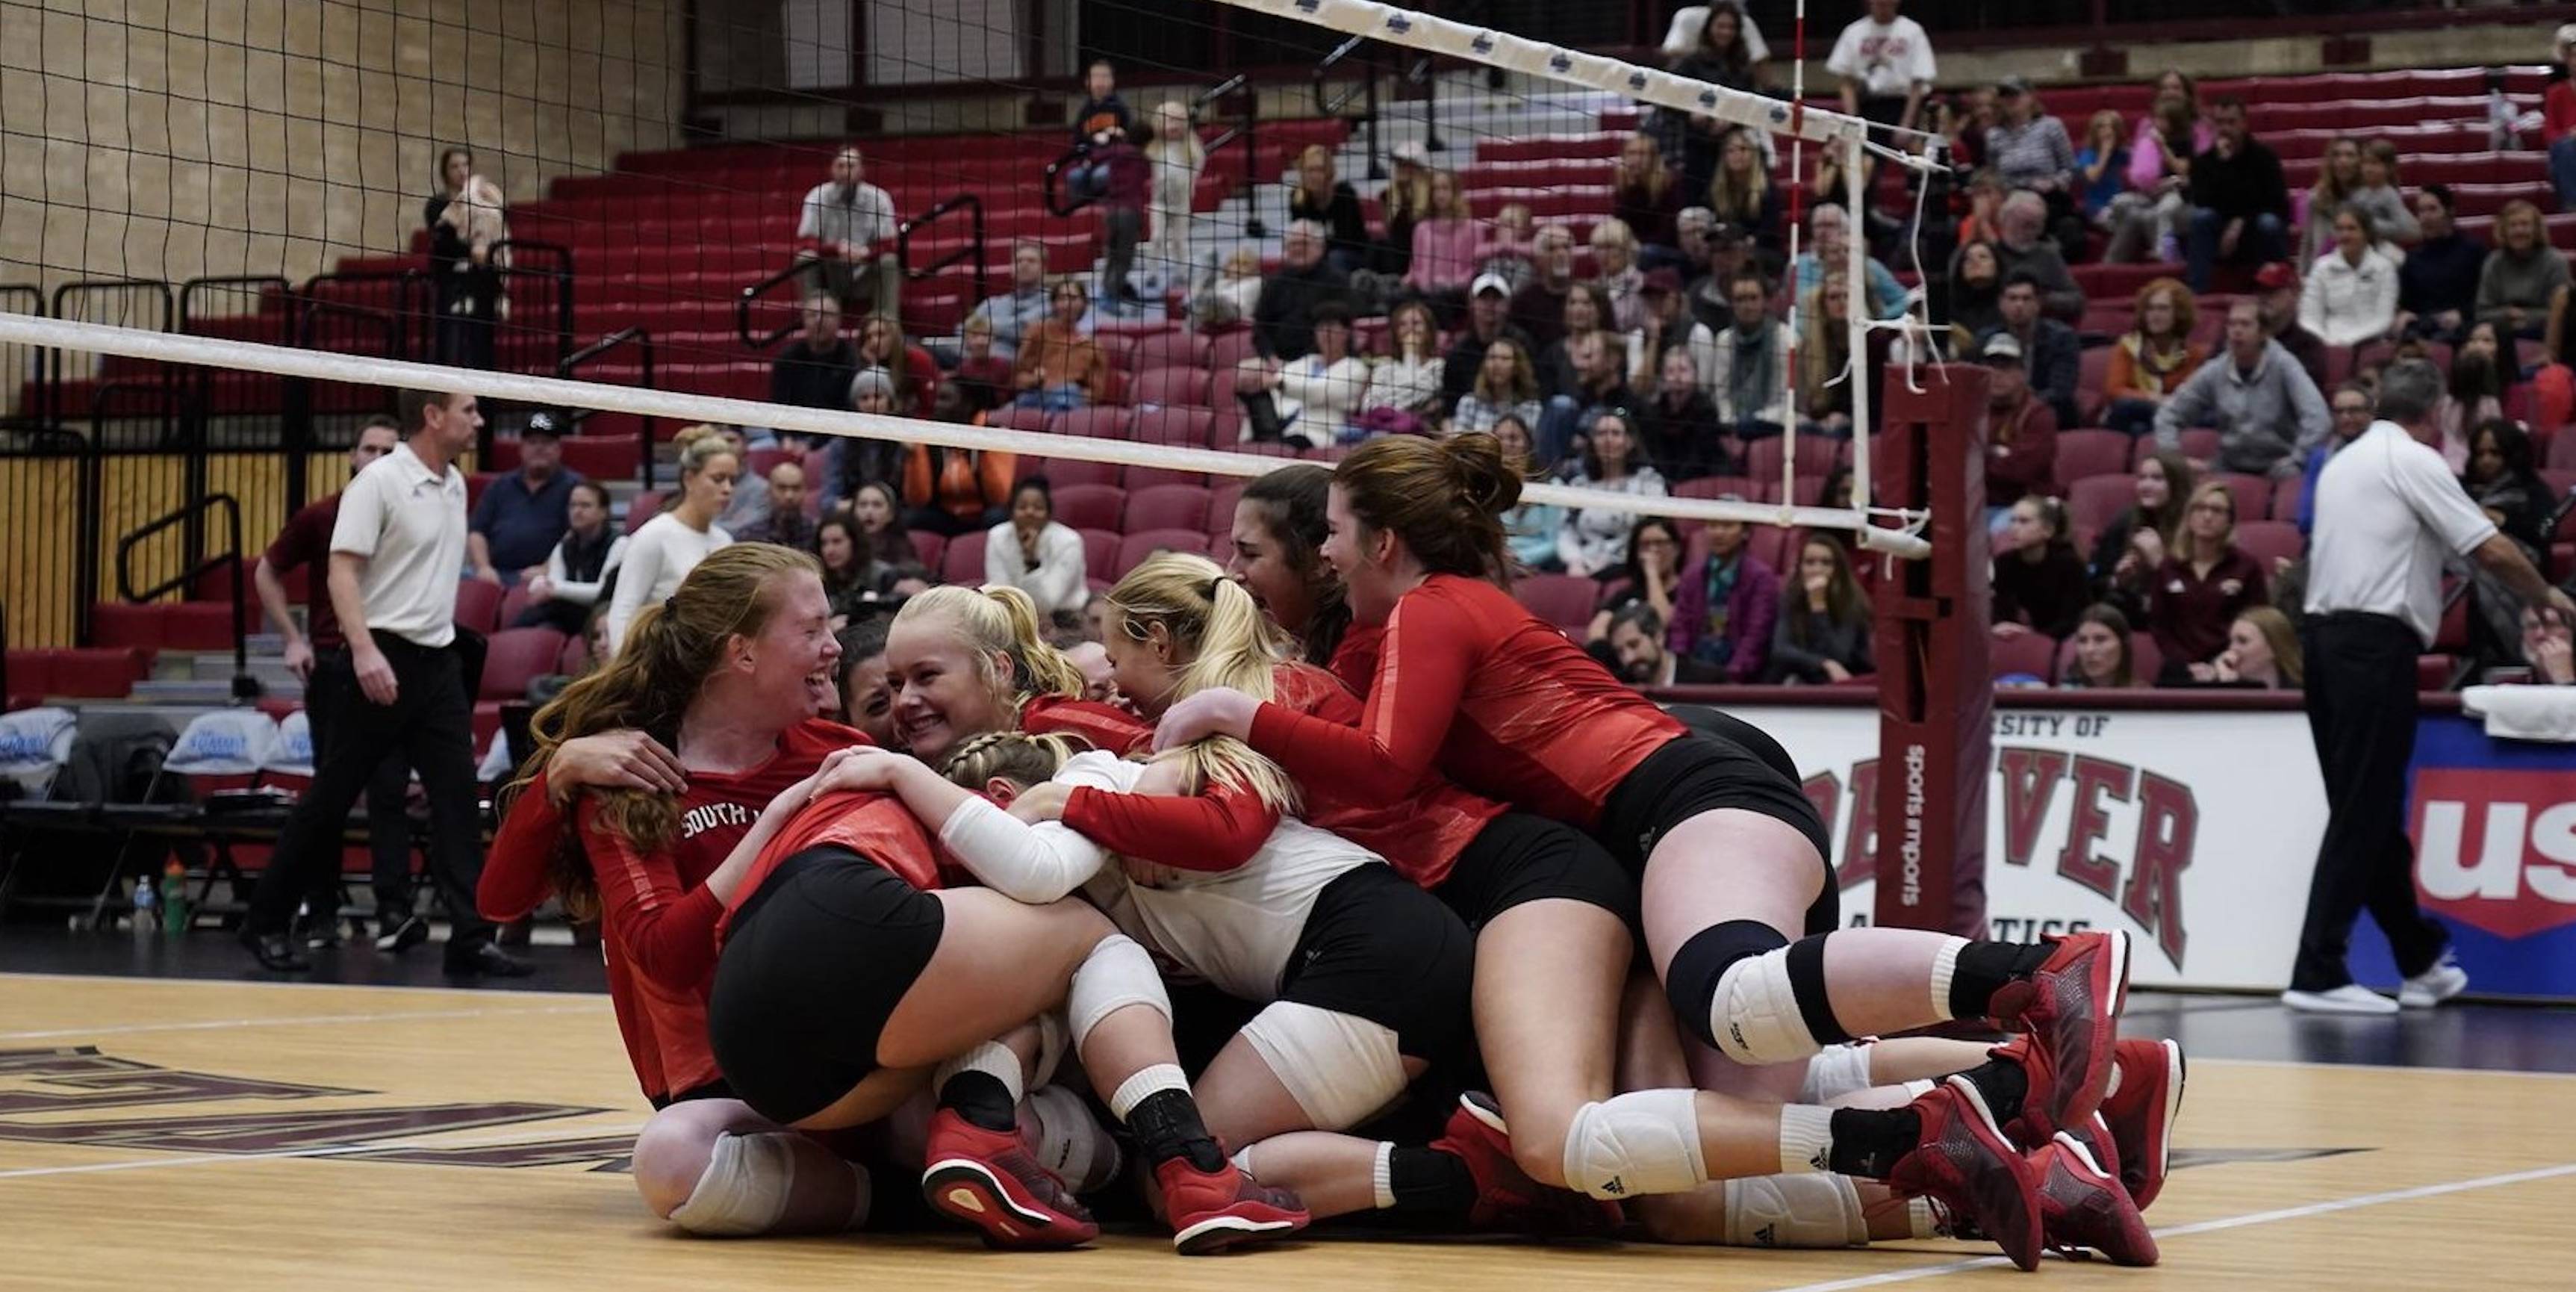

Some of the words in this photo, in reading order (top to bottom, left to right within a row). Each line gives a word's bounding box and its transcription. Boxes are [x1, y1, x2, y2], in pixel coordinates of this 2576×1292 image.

[2076, 715, 2110, 738] OF
[1905, 745, 1926, 816] sports
[681, 802, 747, 839] SOUTH
